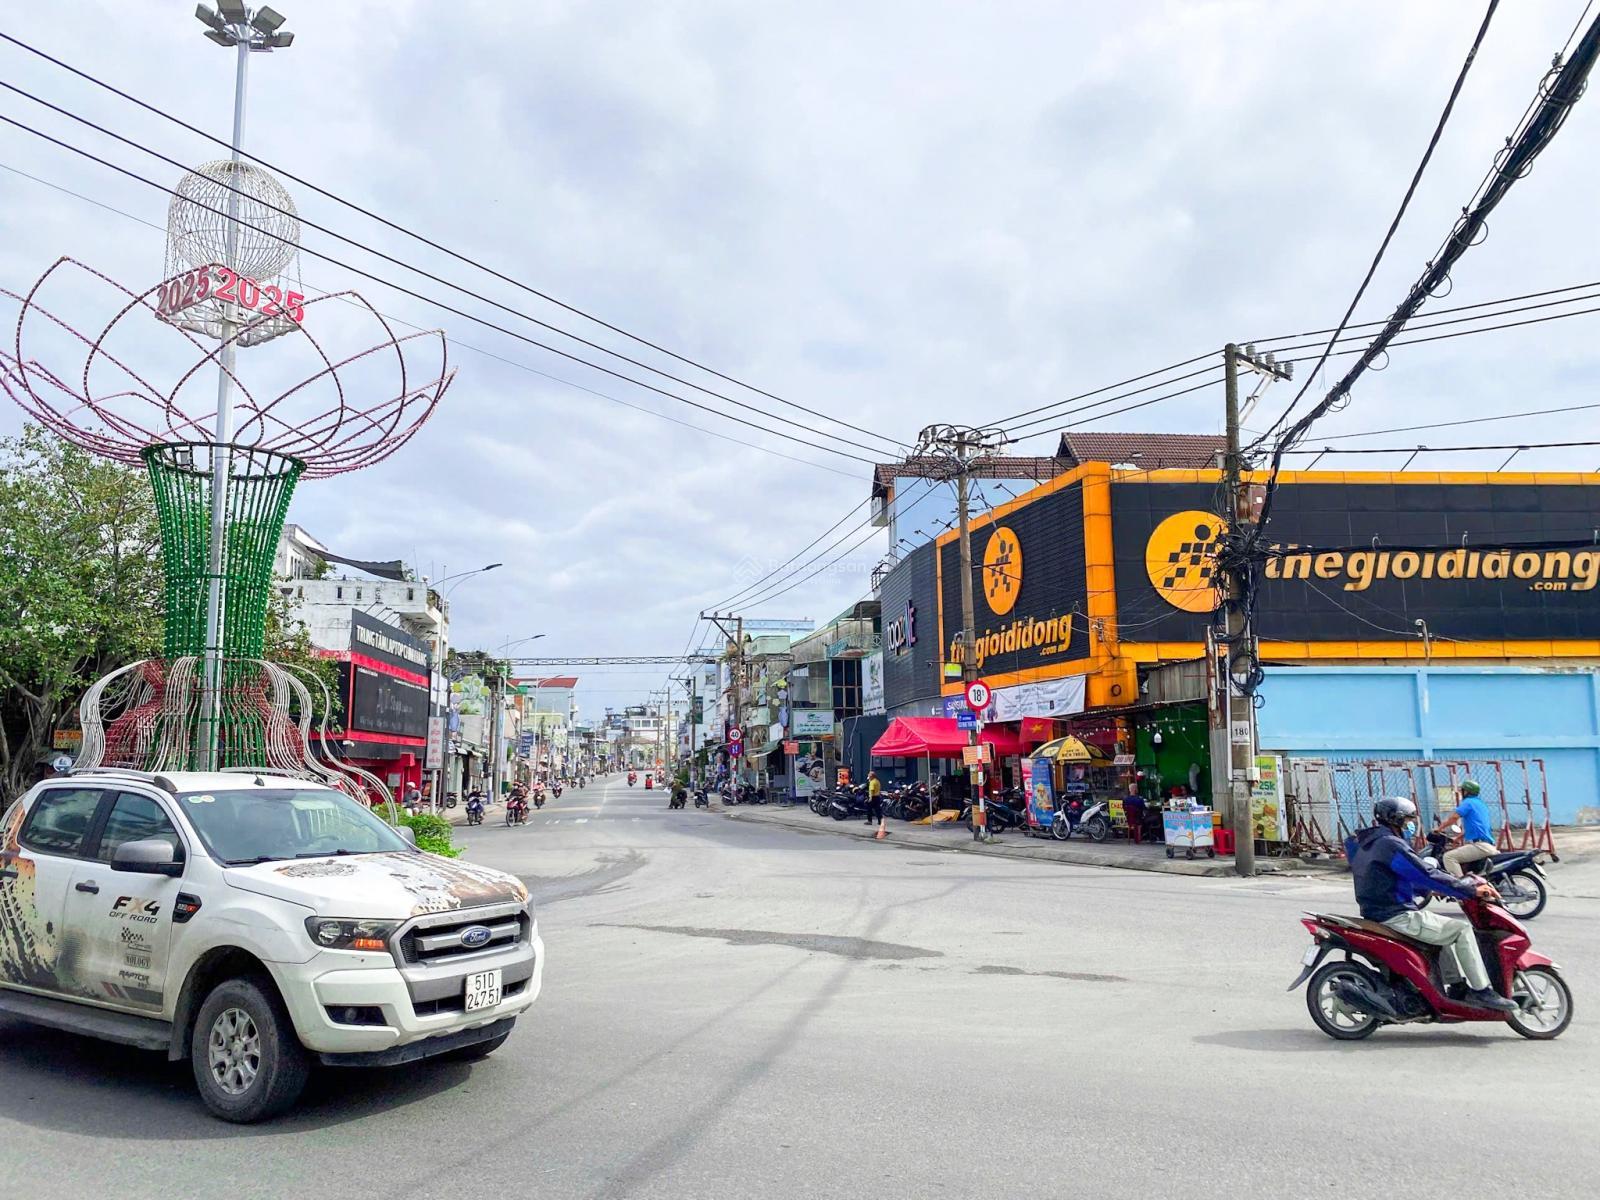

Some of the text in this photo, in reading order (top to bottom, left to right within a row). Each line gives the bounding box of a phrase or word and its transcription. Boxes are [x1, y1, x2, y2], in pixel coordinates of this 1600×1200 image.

[156, 265, 211, 316] 2025
[215, 267, 305, 323] 2025
[1529, 581, 1568, 591] .com
[1234, 727, 1249, 736] 180
[112, 895, 161, 916] FX4
[109, 911, 158, 924] OFF ROAD
[469, 930, 487, 943] Ford
[118, 970, 150, 985] RAPTOR
[475, 972, 495, 990] 51D
[467, 988, 499, 1010] 247.51
